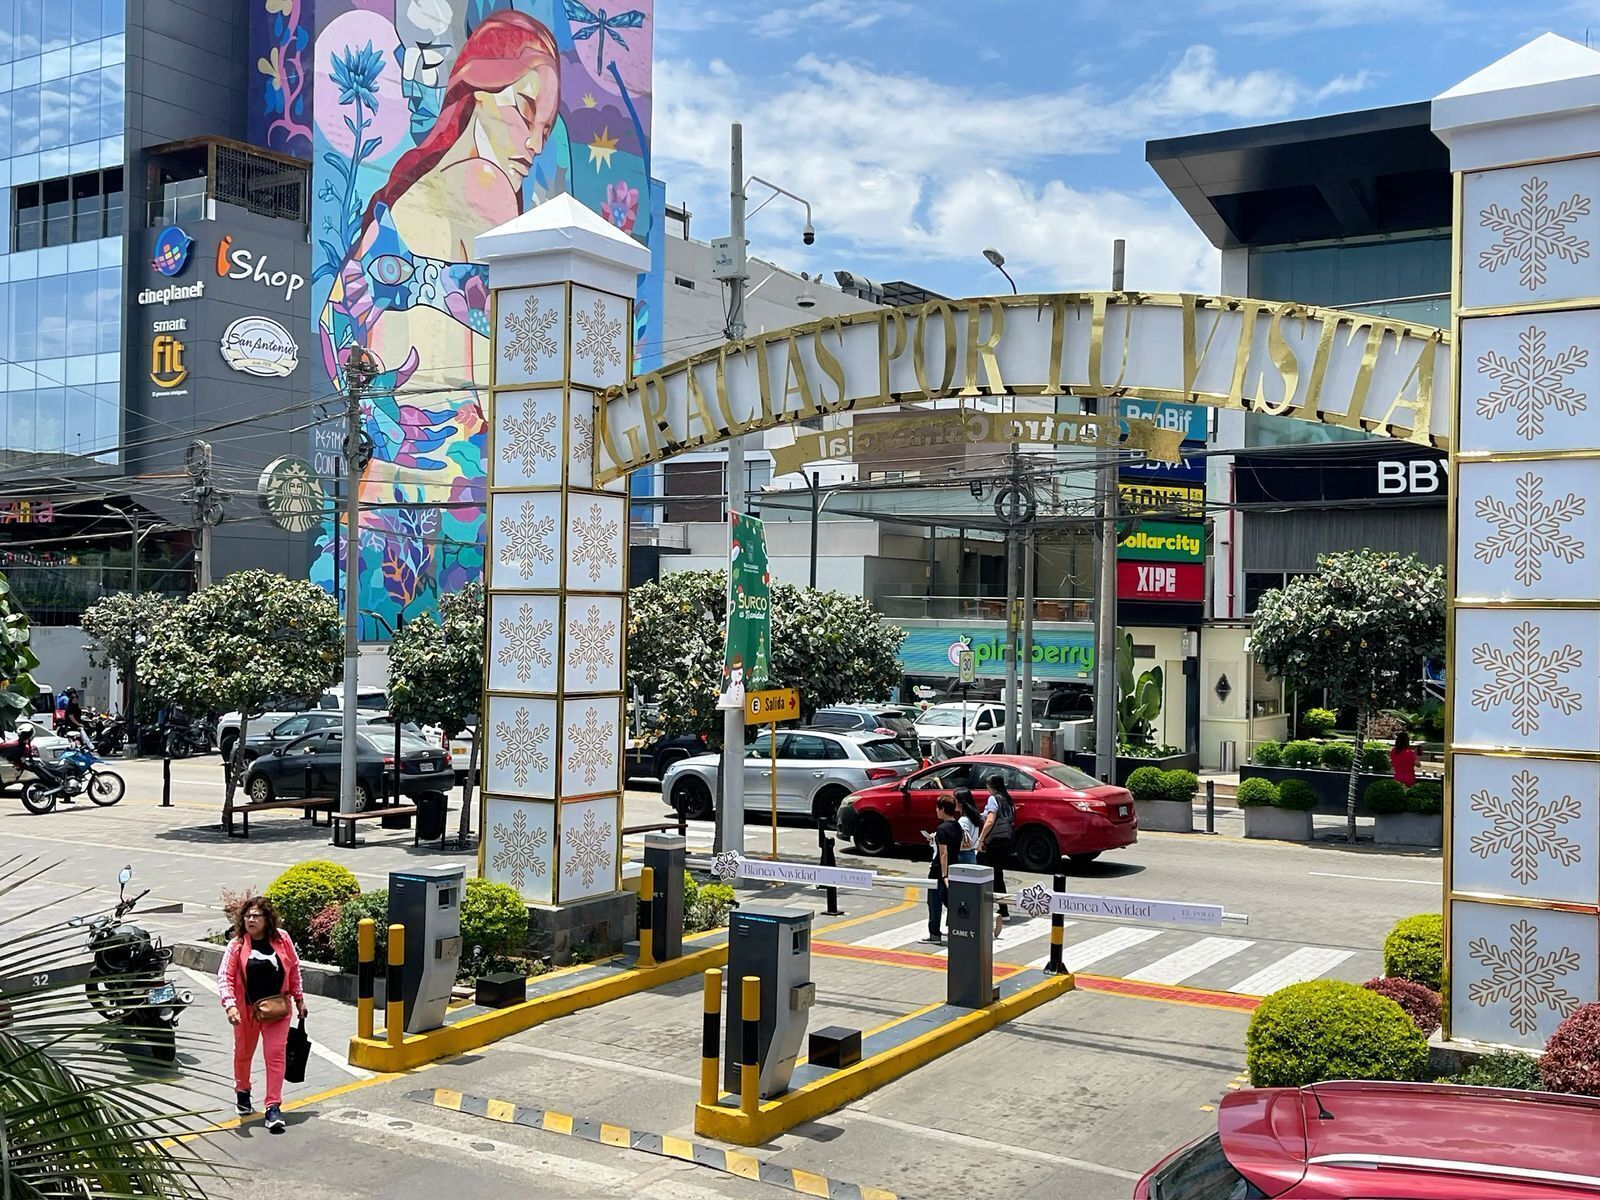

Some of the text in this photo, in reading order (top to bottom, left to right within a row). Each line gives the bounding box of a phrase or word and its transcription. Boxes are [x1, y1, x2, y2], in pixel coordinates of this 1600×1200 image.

[216, 235, 305, 301] iShop
[138, 280, 204, 305] cineplanet
[153, 318, 187, 332] smart
[152, 335, 185, 374] fit
[598, 292, 1437, 472] GRACIAS POR TU VISITA
[1117, 532, 1200, 556] ollarcity
[1137, 566, 1176, 593] XIPE
[738, 594, 767, 611] SURCO
[974, 638, 1095, 672] pinberry
[753, 696, 785, 711] E Salida
[744, 864, 817, 881] Blanca Navidad
[1058, 898, 1151, 917] Blanca Navidad
[952, 929, 969, 938] CAME
[32, 974, 49, 987] 32
